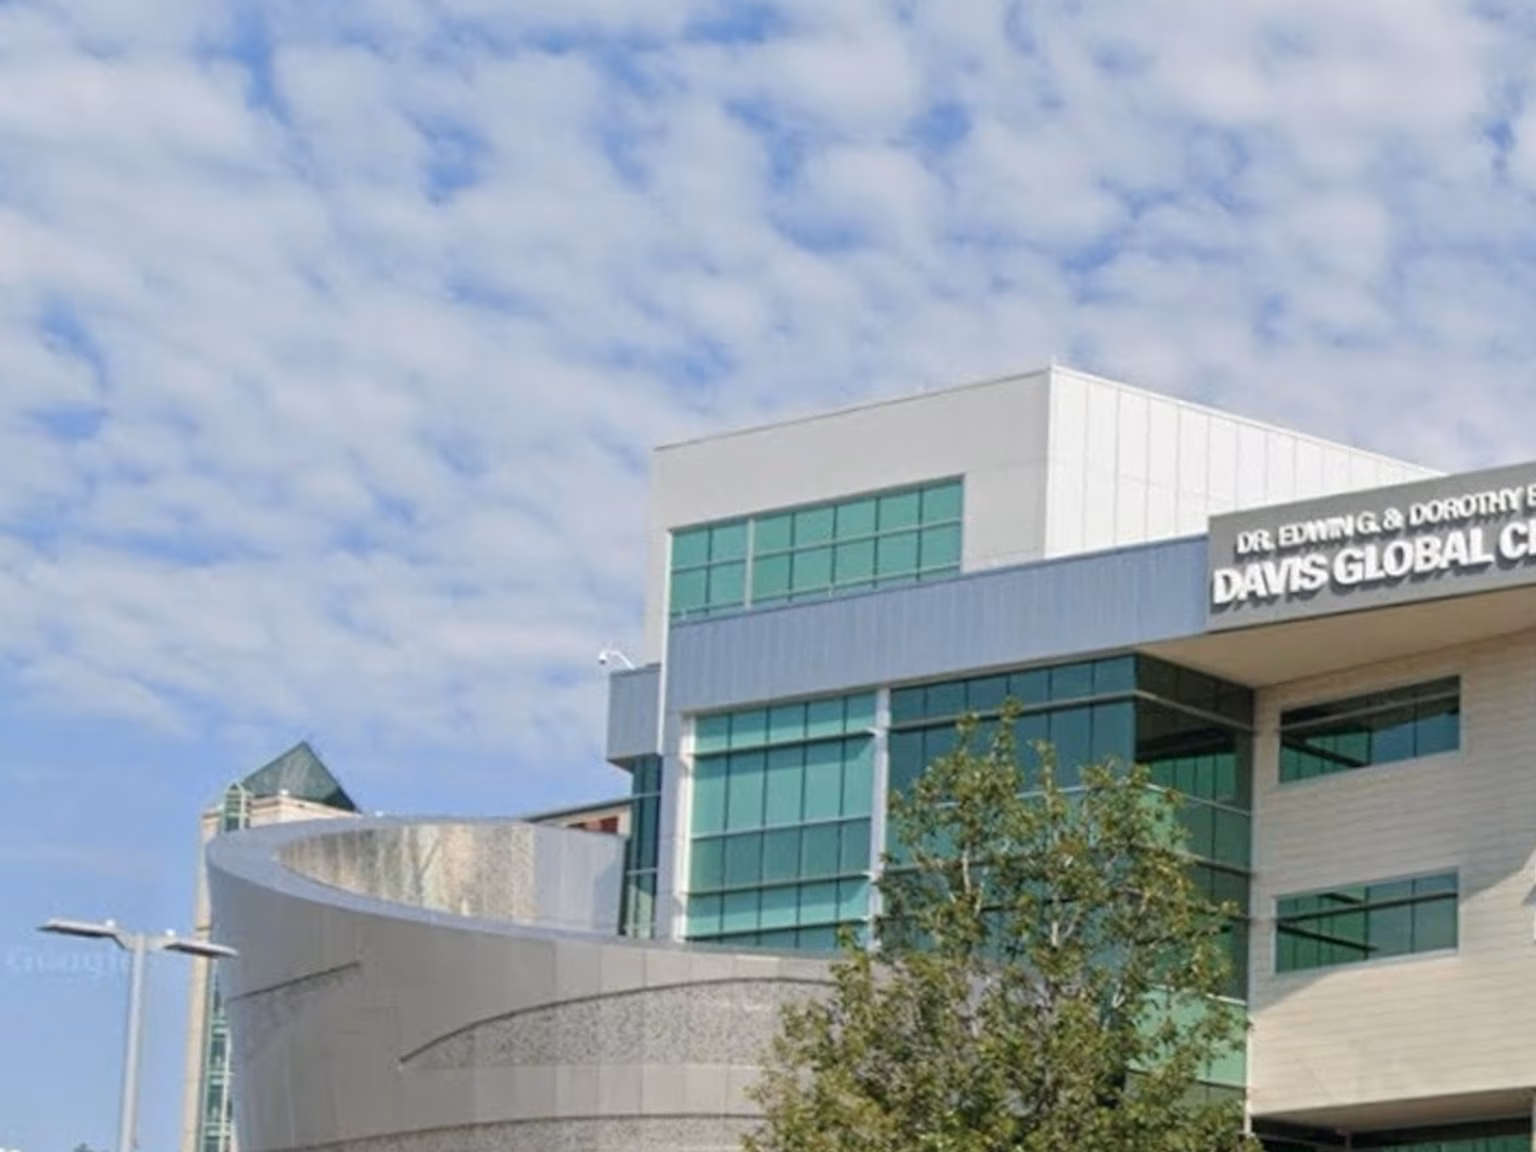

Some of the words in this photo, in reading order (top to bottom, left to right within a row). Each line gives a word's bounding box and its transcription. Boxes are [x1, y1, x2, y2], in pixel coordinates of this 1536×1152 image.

[1236, 529, 1271, 555] DR.
[1278, 514, 1354, 547] EDWIN
[1357, 511, 1381, 535] G.
[1383, 507, 1404, 531] &
[1409, 486, 1525, 525] DOROTHY
[1212, 554, 1328, 605] DAVIS
[1333, 531, 1494, 586] GLOBAL
